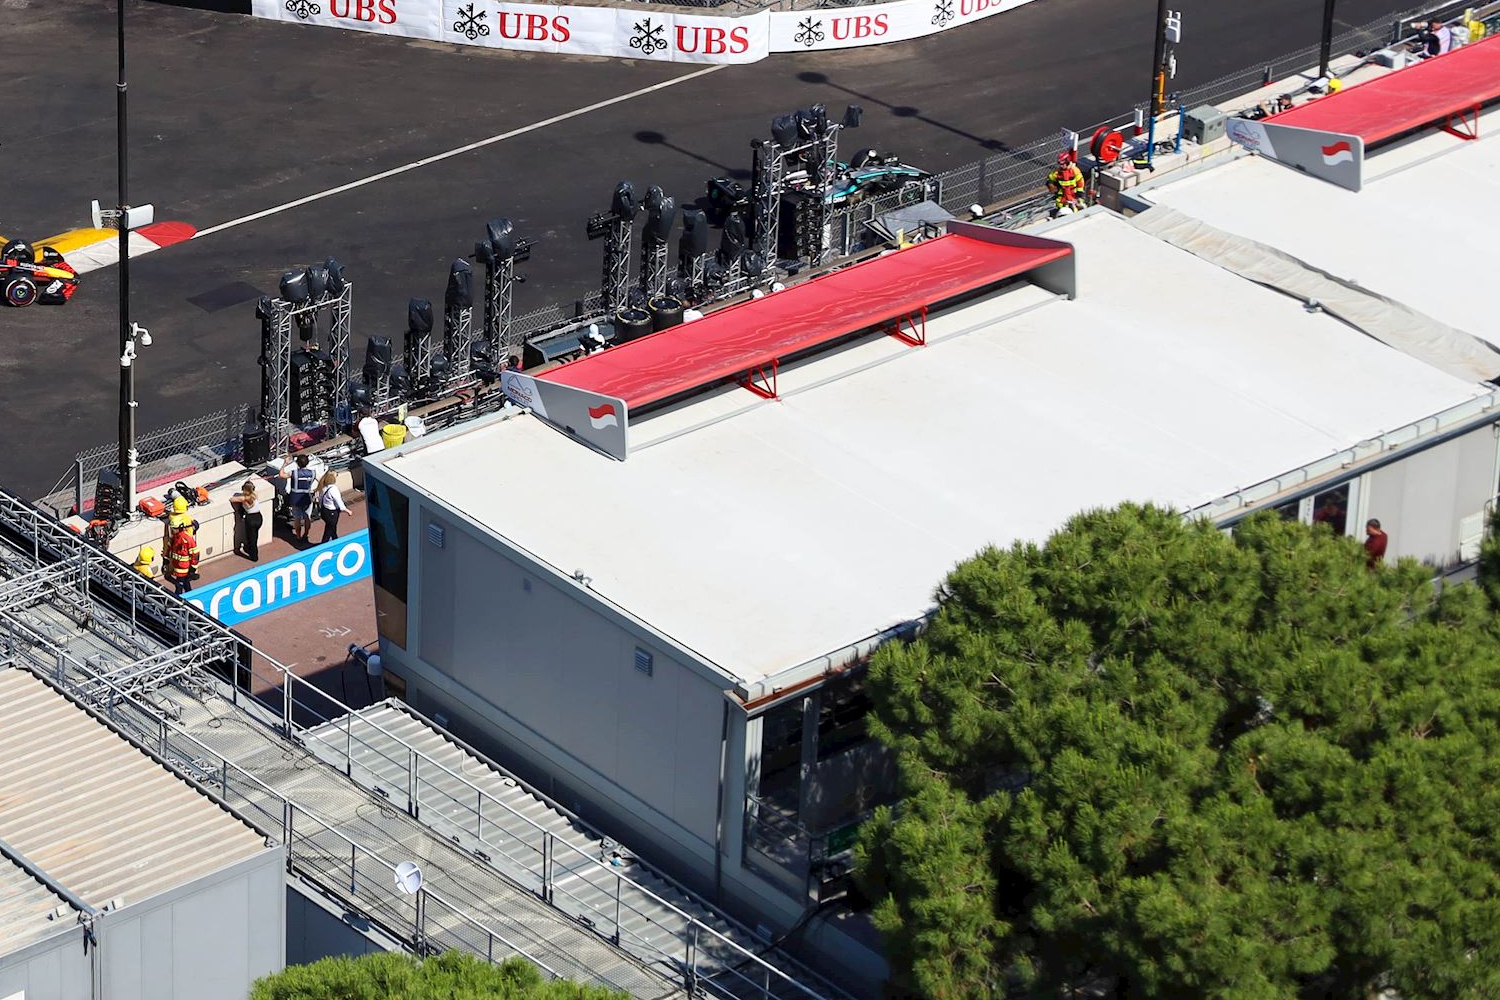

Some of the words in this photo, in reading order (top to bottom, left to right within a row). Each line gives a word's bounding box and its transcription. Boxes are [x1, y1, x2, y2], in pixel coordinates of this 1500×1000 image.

[497, 11, 571, 43] UBS
[674, 24, 749, 54] UBS
[831, 13, 889, 41] UBS
[188, 542, 366, 620] ramco
